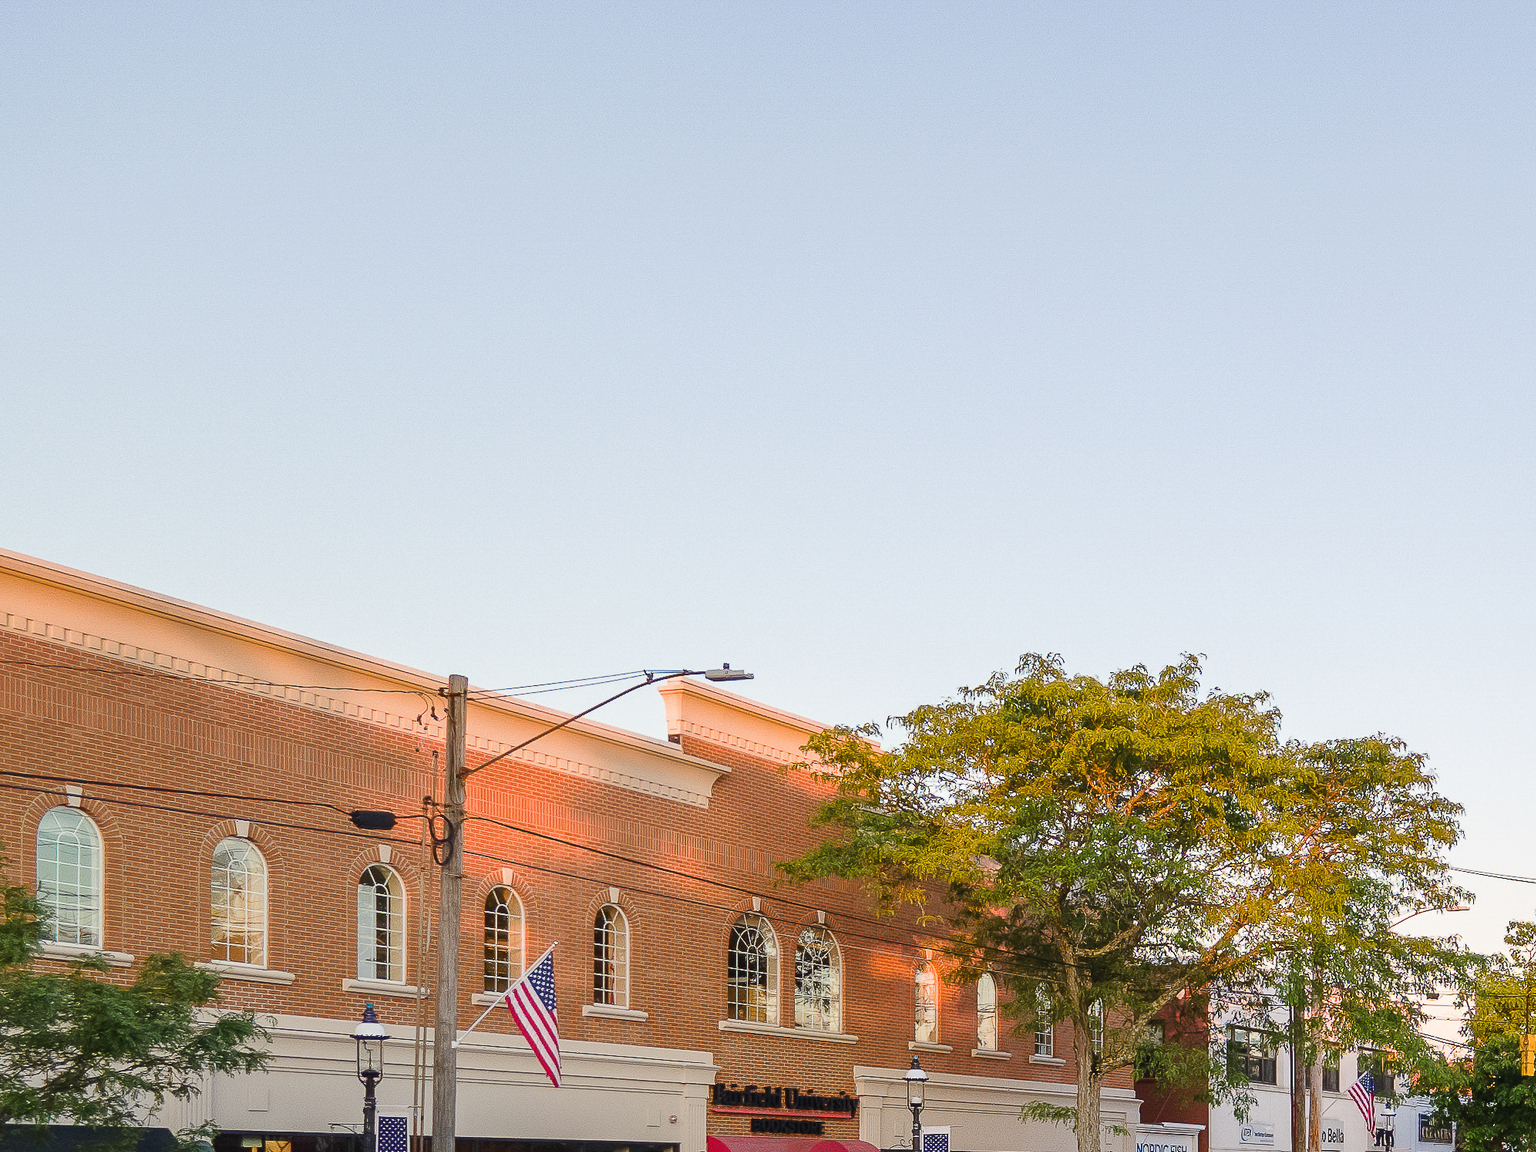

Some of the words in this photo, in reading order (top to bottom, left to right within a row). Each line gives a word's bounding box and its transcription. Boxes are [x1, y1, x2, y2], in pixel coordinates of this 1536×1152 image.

[713, 1083, 782, 1107] Fairfield
[784, 1088, 859, 1118] University
[751, 1119, 825, 1134] BOOKSTORE
[1327, 1128, 1345, 1144] Bella
